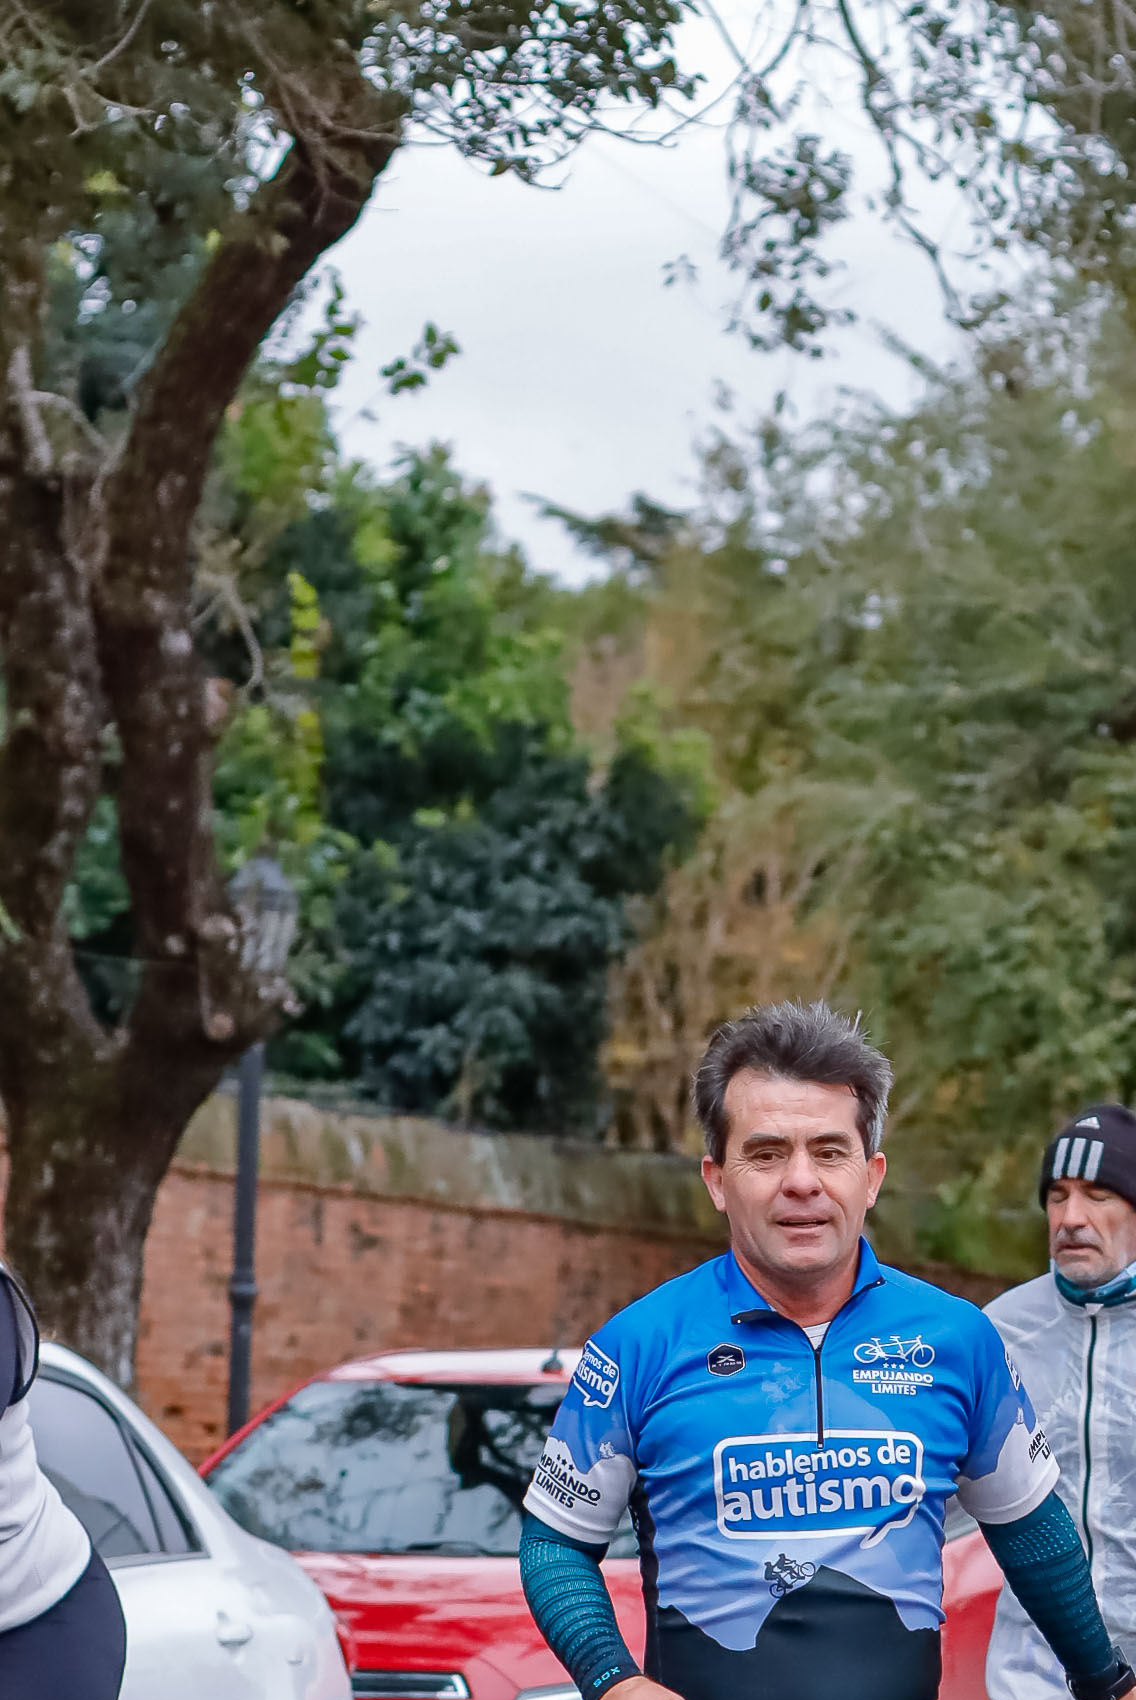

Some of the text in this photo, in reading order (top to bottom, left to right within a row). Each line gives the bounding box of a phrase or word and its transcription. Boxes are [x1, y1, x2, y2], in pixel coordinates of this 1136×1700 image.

[602, 1363, 617, 1378] de
[852, 1370, 934, 1384] EMPUJANDO
[540, 1453, 601, 1502] MPUJANDO
[728, 1437, 911, 1483] hablemos de
[723, 1472, 927, 1523] autismo
